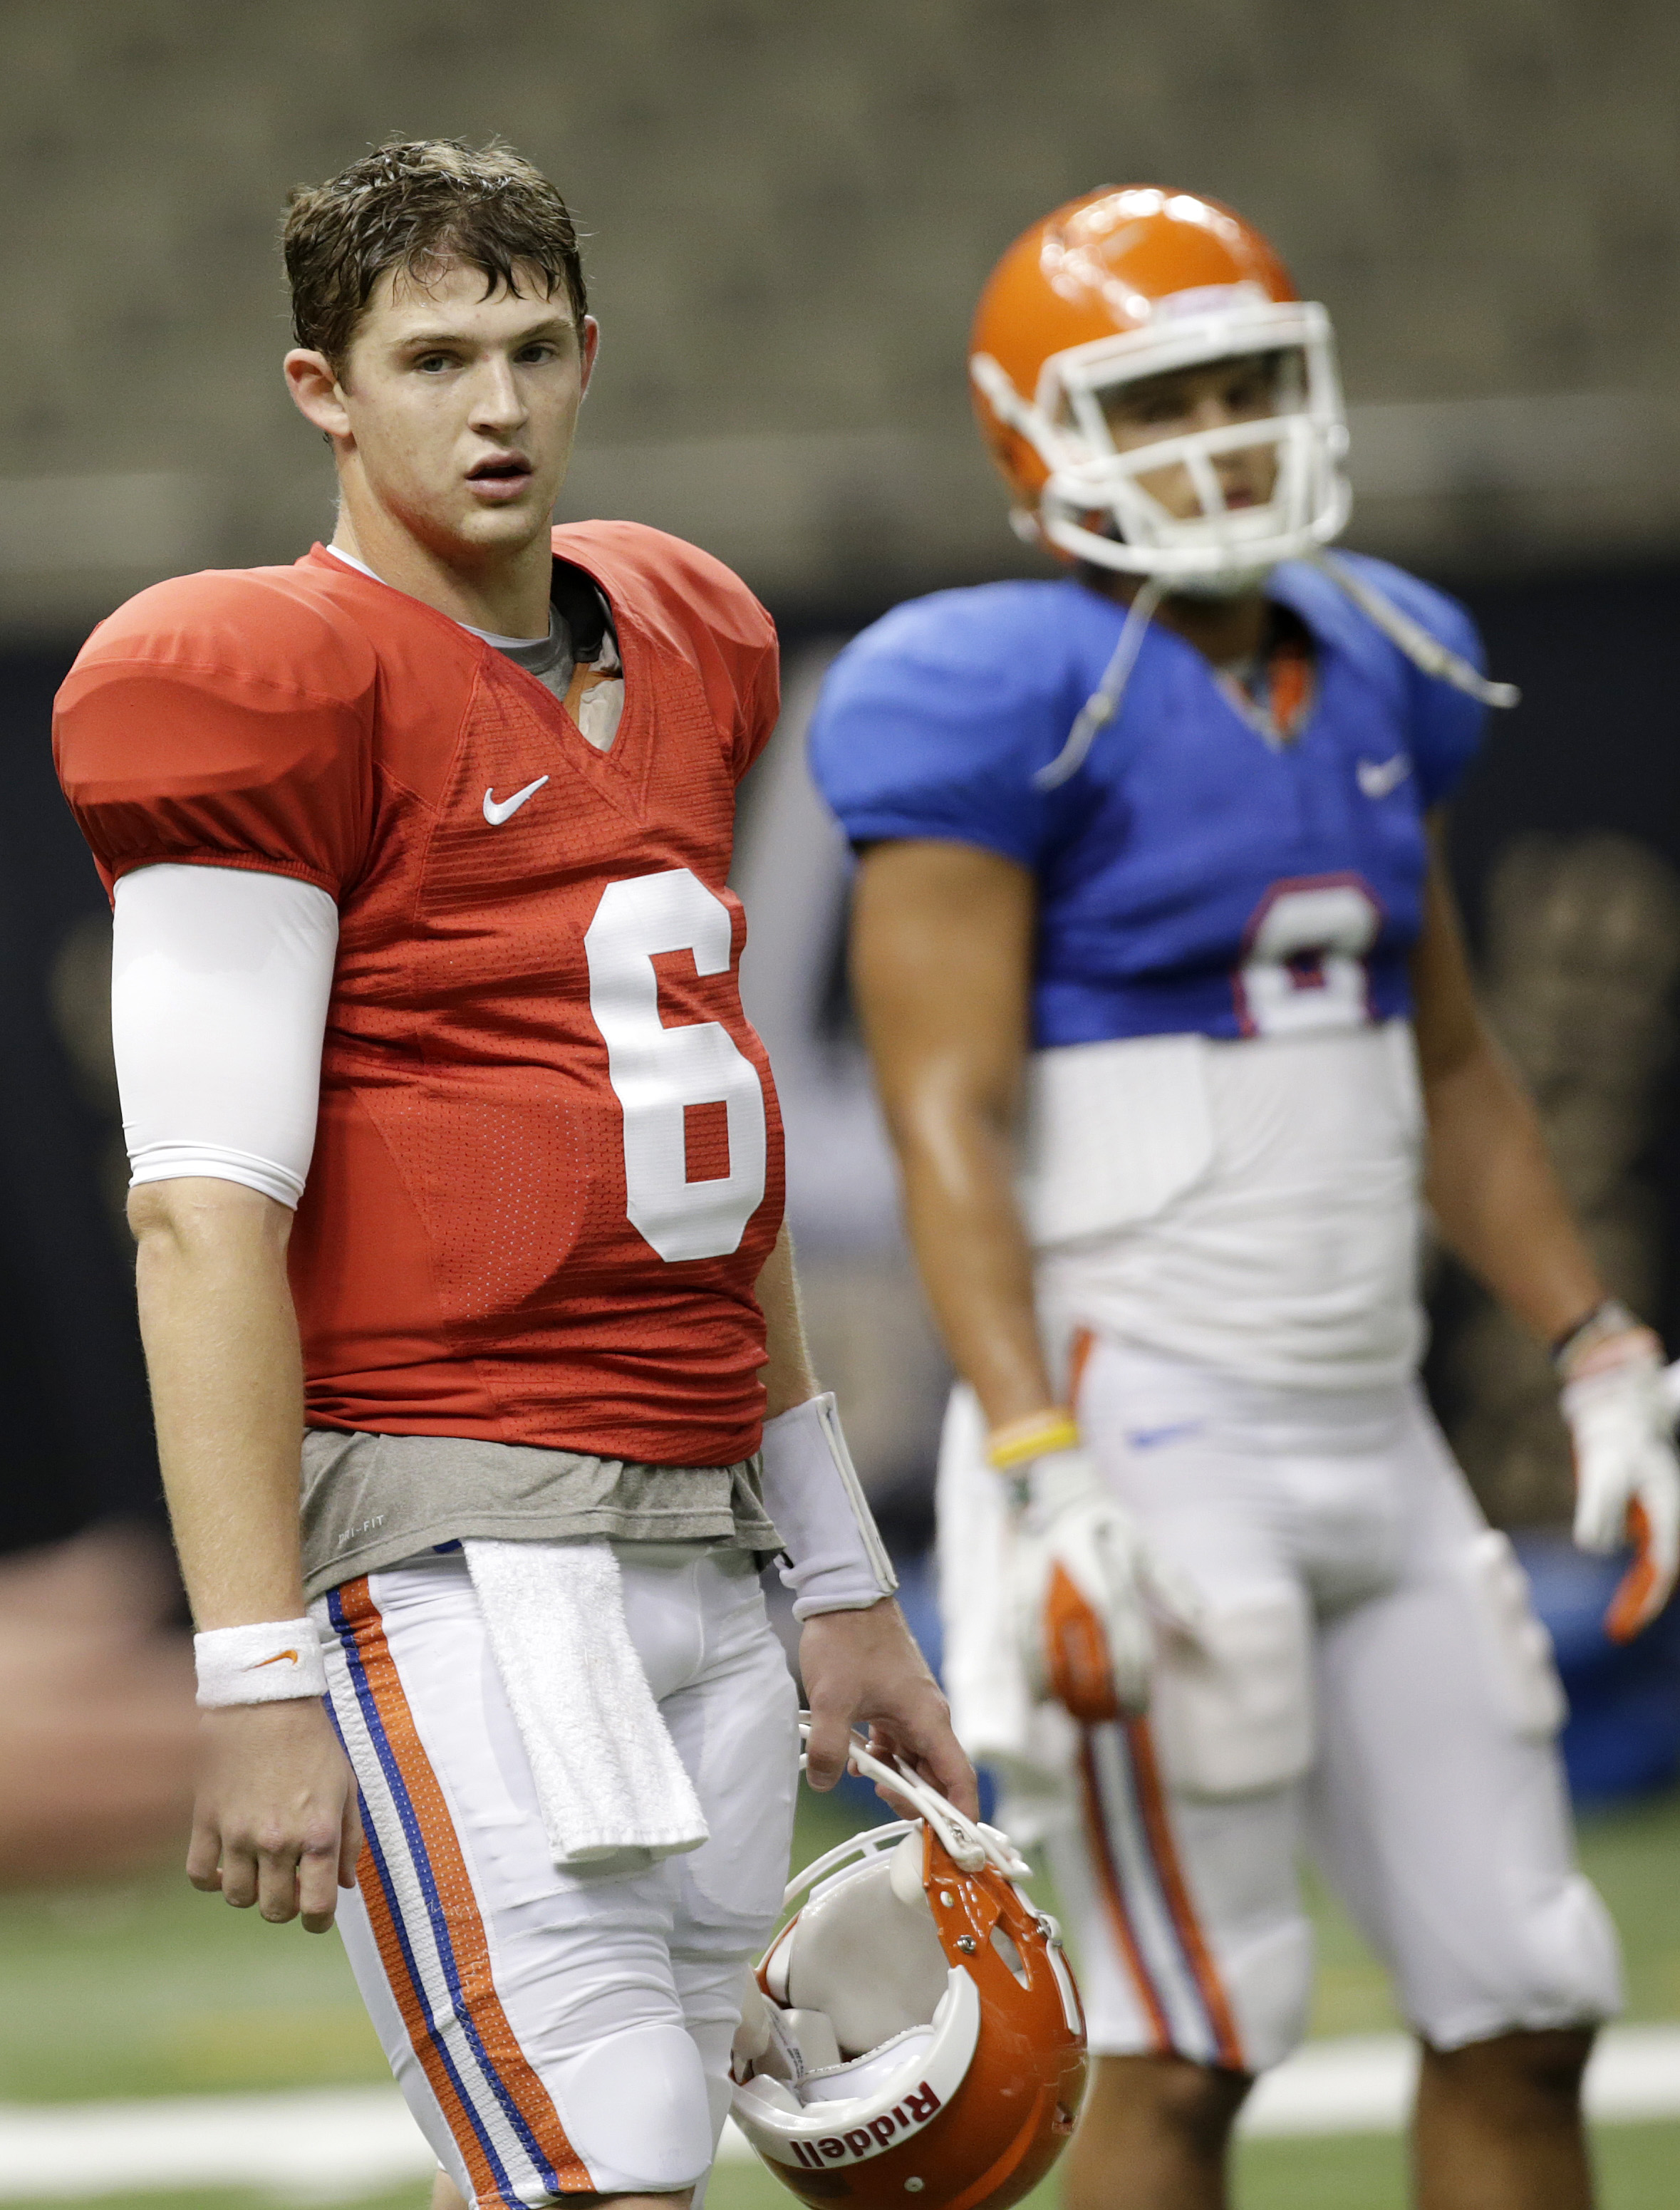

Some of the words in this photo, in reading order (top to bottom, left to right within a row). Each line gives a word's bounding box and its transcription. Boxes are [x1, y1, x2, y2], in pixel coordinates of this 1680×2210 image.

[584, 868, 767, 1262] 6
[338, 1514, 385, 1545] DRI-FIT
[789, 2080, 942, 2168] Riddell
